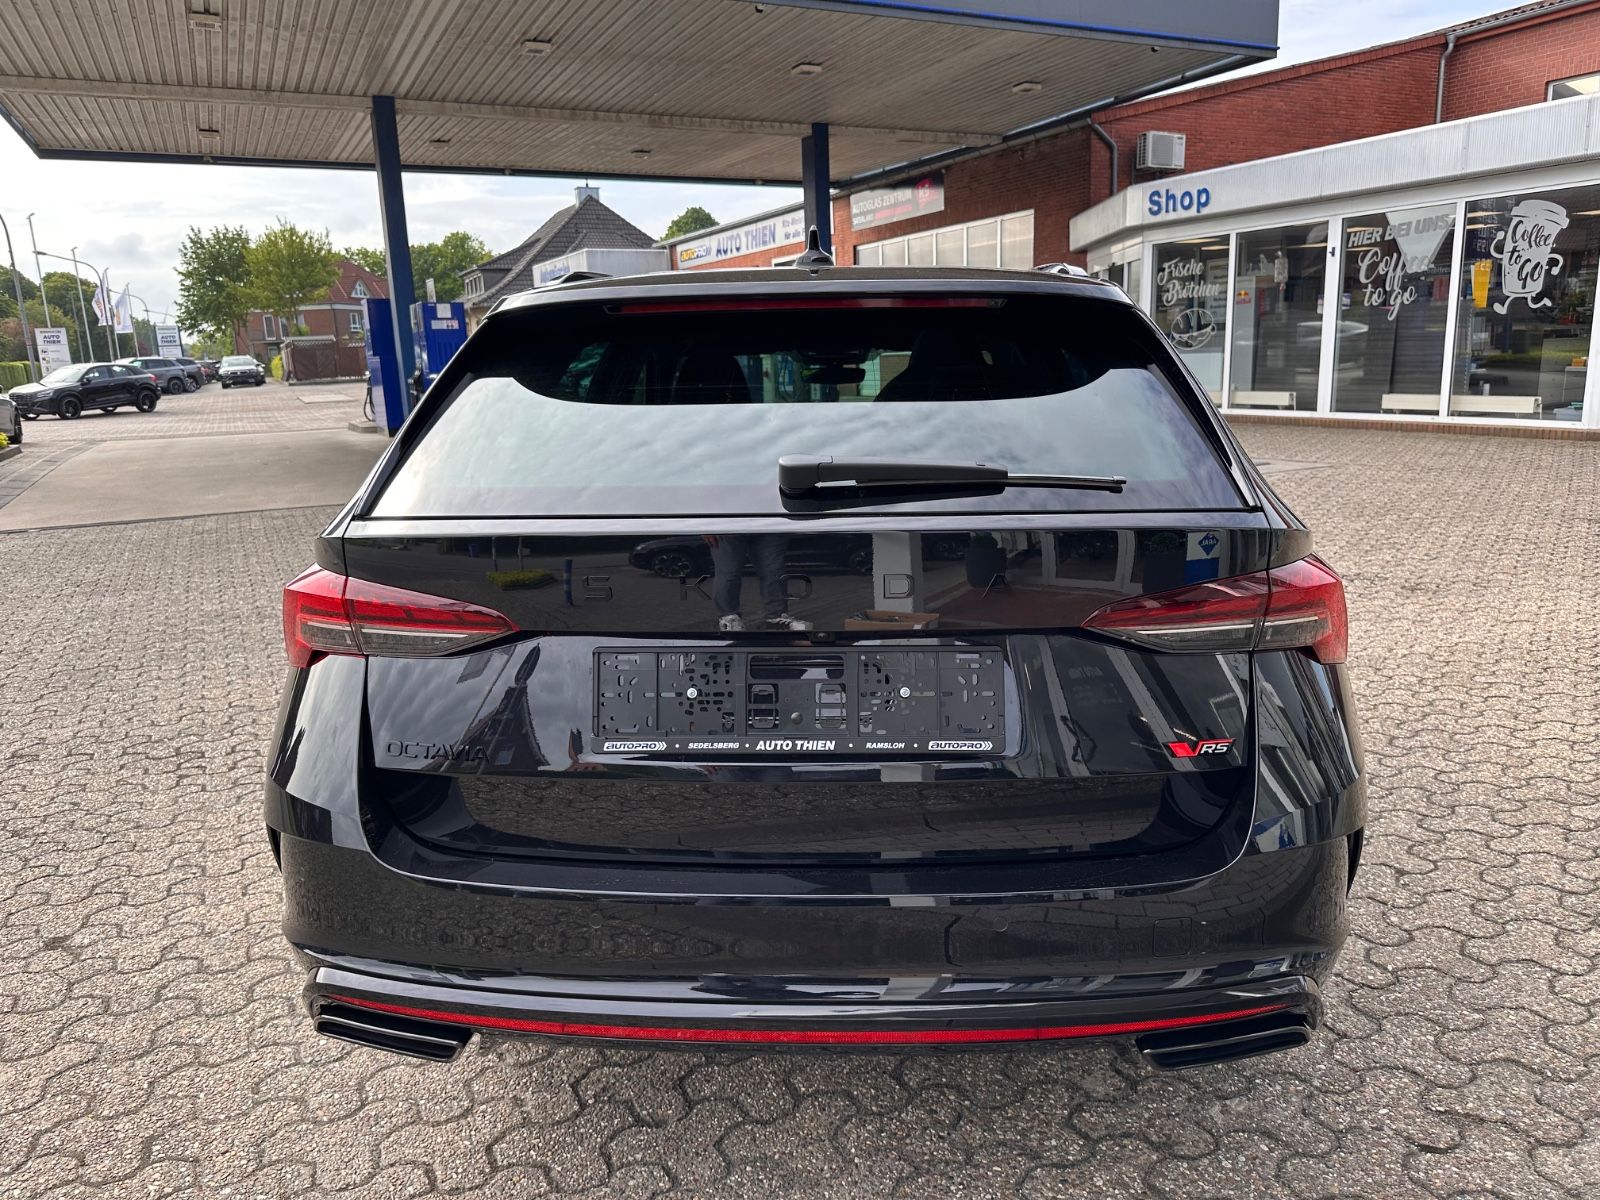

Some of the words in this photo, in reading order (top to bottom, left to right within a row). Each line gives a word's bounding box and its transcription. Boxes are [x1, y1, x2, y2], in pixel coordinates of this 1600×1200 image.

[852, 197, 882, 215] AUTOGLAS
[882, 188, 913, 207] ZENTRUM
[1148, 187, 1211, 216] Shop
[716, 233, 742, 257] AUTO
[745, 223, 777, 250] THIEN
[1348, 228, 1381, 249] HIER
[1384, 221, 1411, 241] BEI
[1414, 214, 1451, 235] UNS
[1511, 219, 1553, 248] Coffee
[1358, 247, 1432, 292] Coffee
[1506, 244, 1522, 267] to
[1157, 257, 1205, 286] Frische
[1163, 280, 1220, 306] Brötchen
[1363, 283, 1385, 307] to
[1390, 286, 1417, 320] go
[387, 740, 490, 762] OCTAVIA
[687, 742, 740, 750] SEDELSBERG
[755, 740, 793, 751] AUTO
[795, 740, 836, 751] THIEN
[865, 742, 906, 750] RAMSLOH
